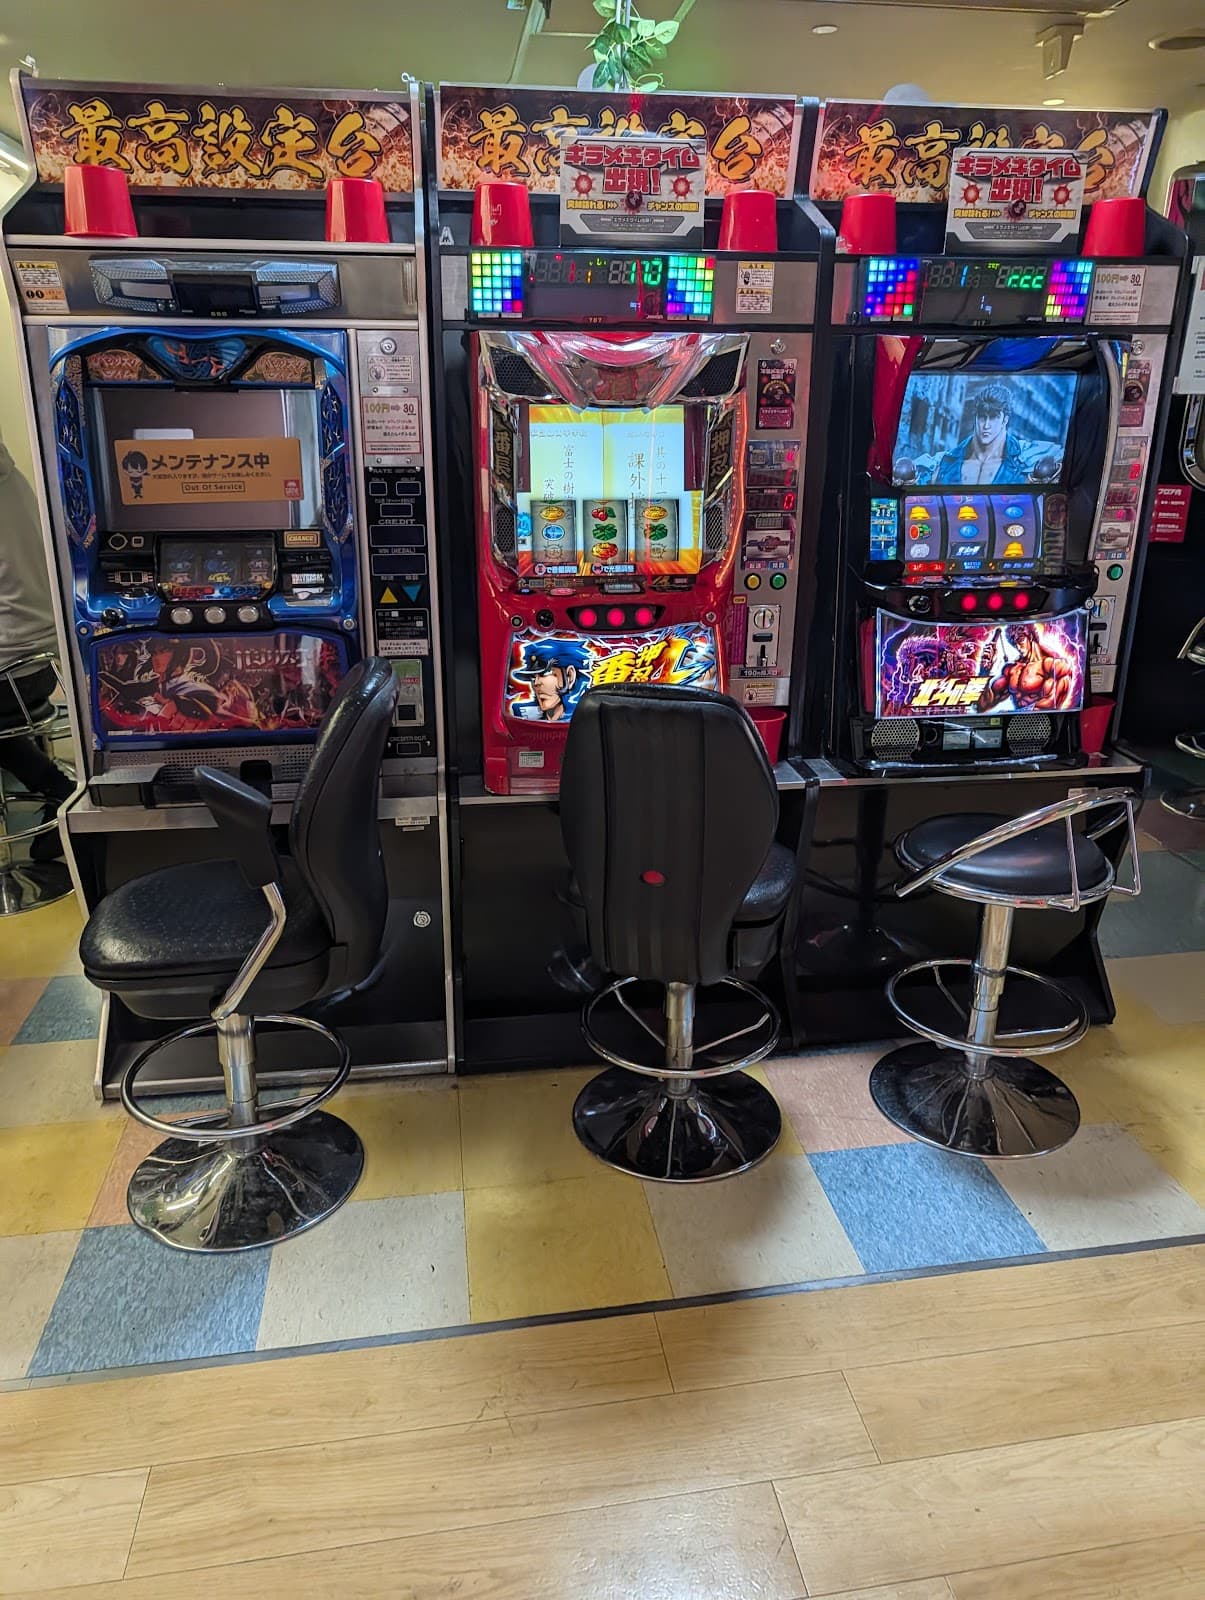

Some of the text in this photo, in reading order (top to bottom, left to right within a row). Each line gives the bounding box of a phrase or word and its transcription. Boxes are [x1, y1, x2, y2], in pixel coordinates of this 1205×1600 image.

[61, 98, 386, 181] 最高設定台
[565, 145, 700, 168] キラメキタイム
[956, 156, 1081, 177] キラメキタイム
[647, 202, 699, 212] チャンスの!
[1028, 211, 1076, 219] チャンスの!
[403, 403, 415, 414] 30
[151, 453, 270, 470] メンテナンス中
[710, 429, 730, 478] 押忍
[214, 482, 243, 490] Service
[911, 676, 992, 706] 北斗の拳
